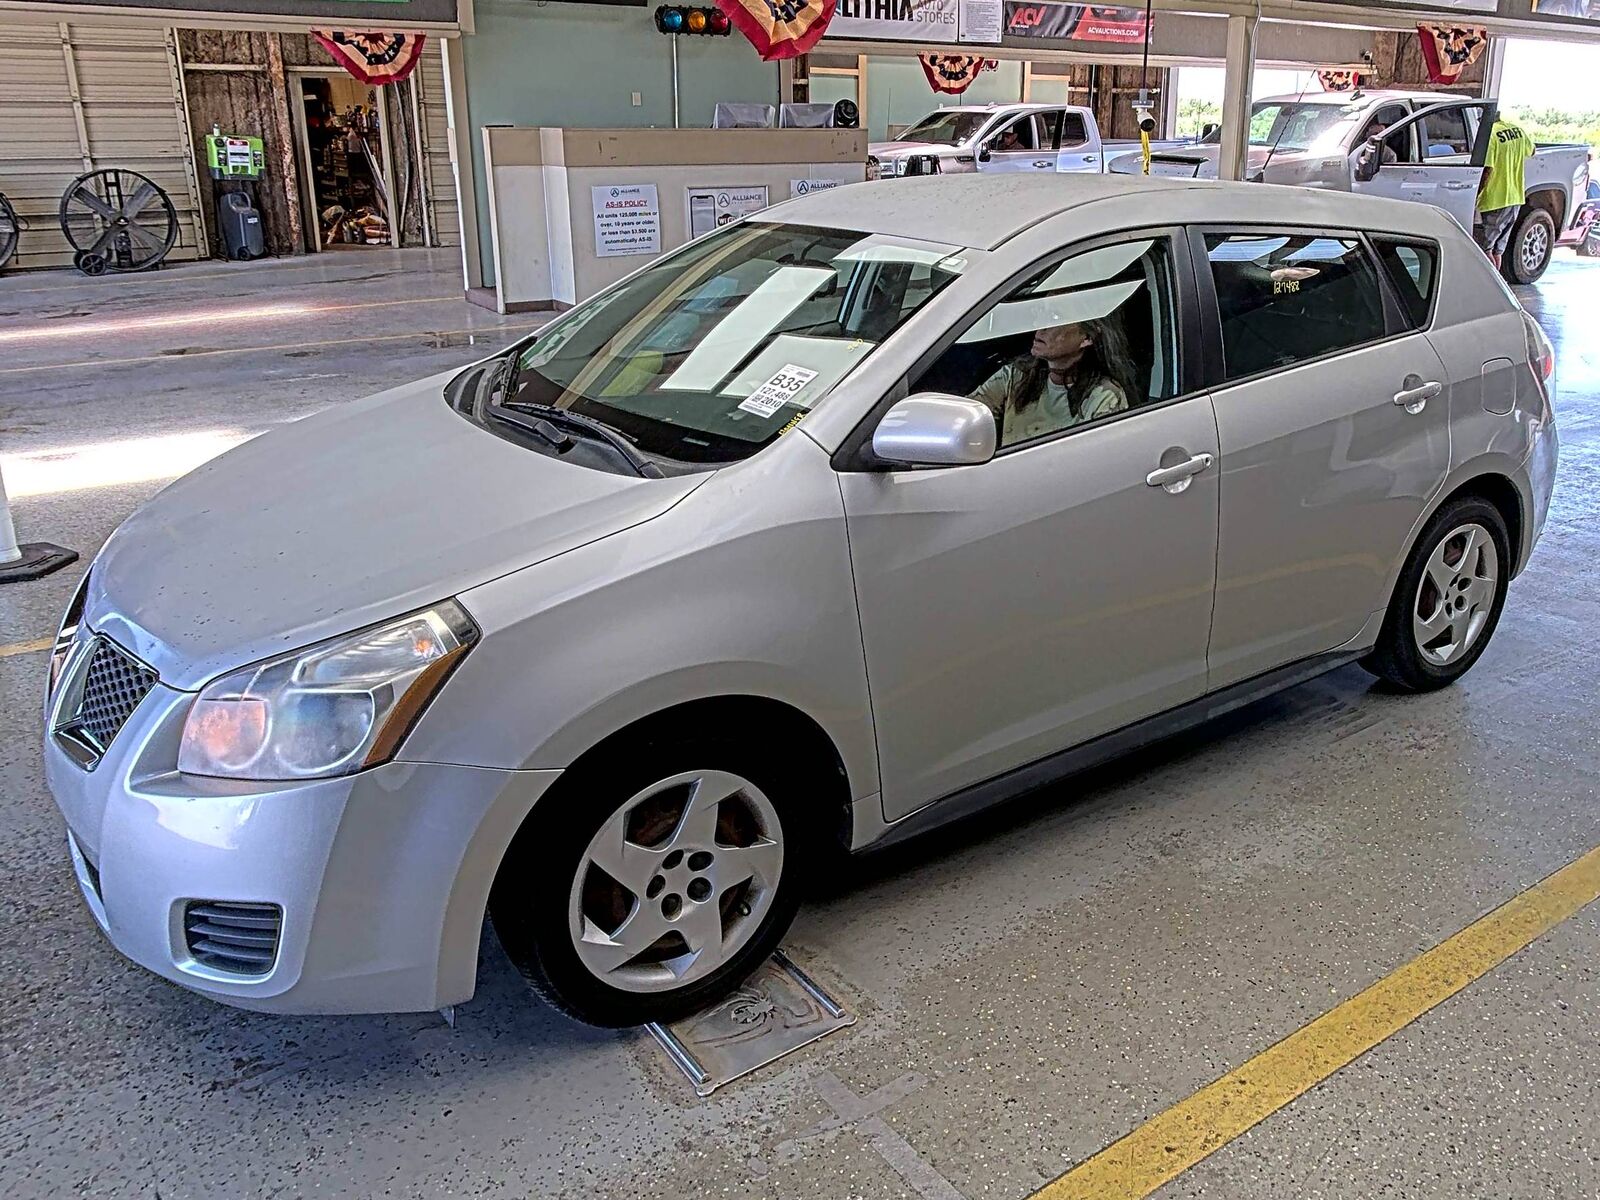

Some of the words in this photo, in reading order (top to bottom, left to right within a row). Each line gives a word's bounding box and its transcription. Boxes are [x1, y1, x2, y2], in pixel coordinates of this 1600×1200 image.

[916, 11, 956, 24] STORES
[1009, 5, 1048, 27] ACV
[1087, 26, 1139, 36] ACVAUCTIONS.COM
[1496, 127, 1523, 143] STAFF
[624, 199, 648, 208] POLICY
[1273, 280, 1300, 294] 127488
[769, 373, 805, 392] B35
[762, 396, 782, 408] 2010
